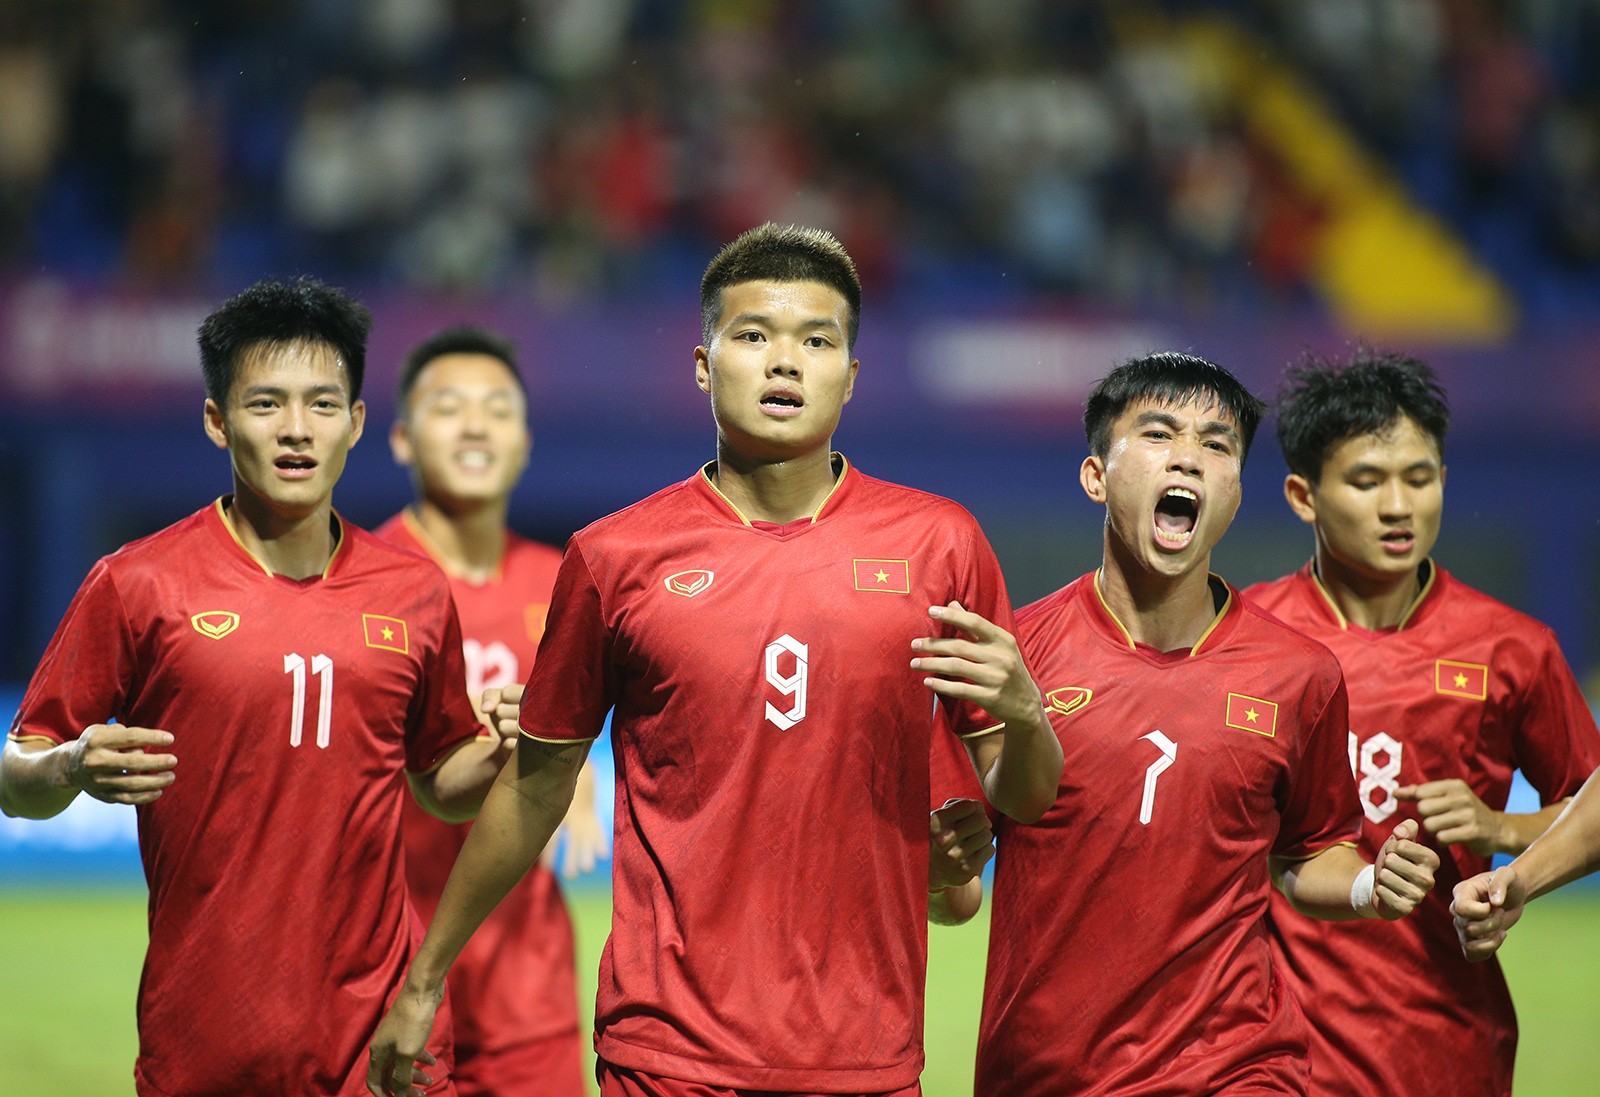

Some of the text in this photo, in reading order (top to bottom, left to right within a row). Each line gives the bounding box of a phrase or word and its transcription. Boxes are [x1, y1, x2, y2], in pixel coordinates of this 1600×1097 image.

[283, 652, 334, 750] 11
[765, 633, 808, 731] 9
[1137, 729, 1178, 825] 7
